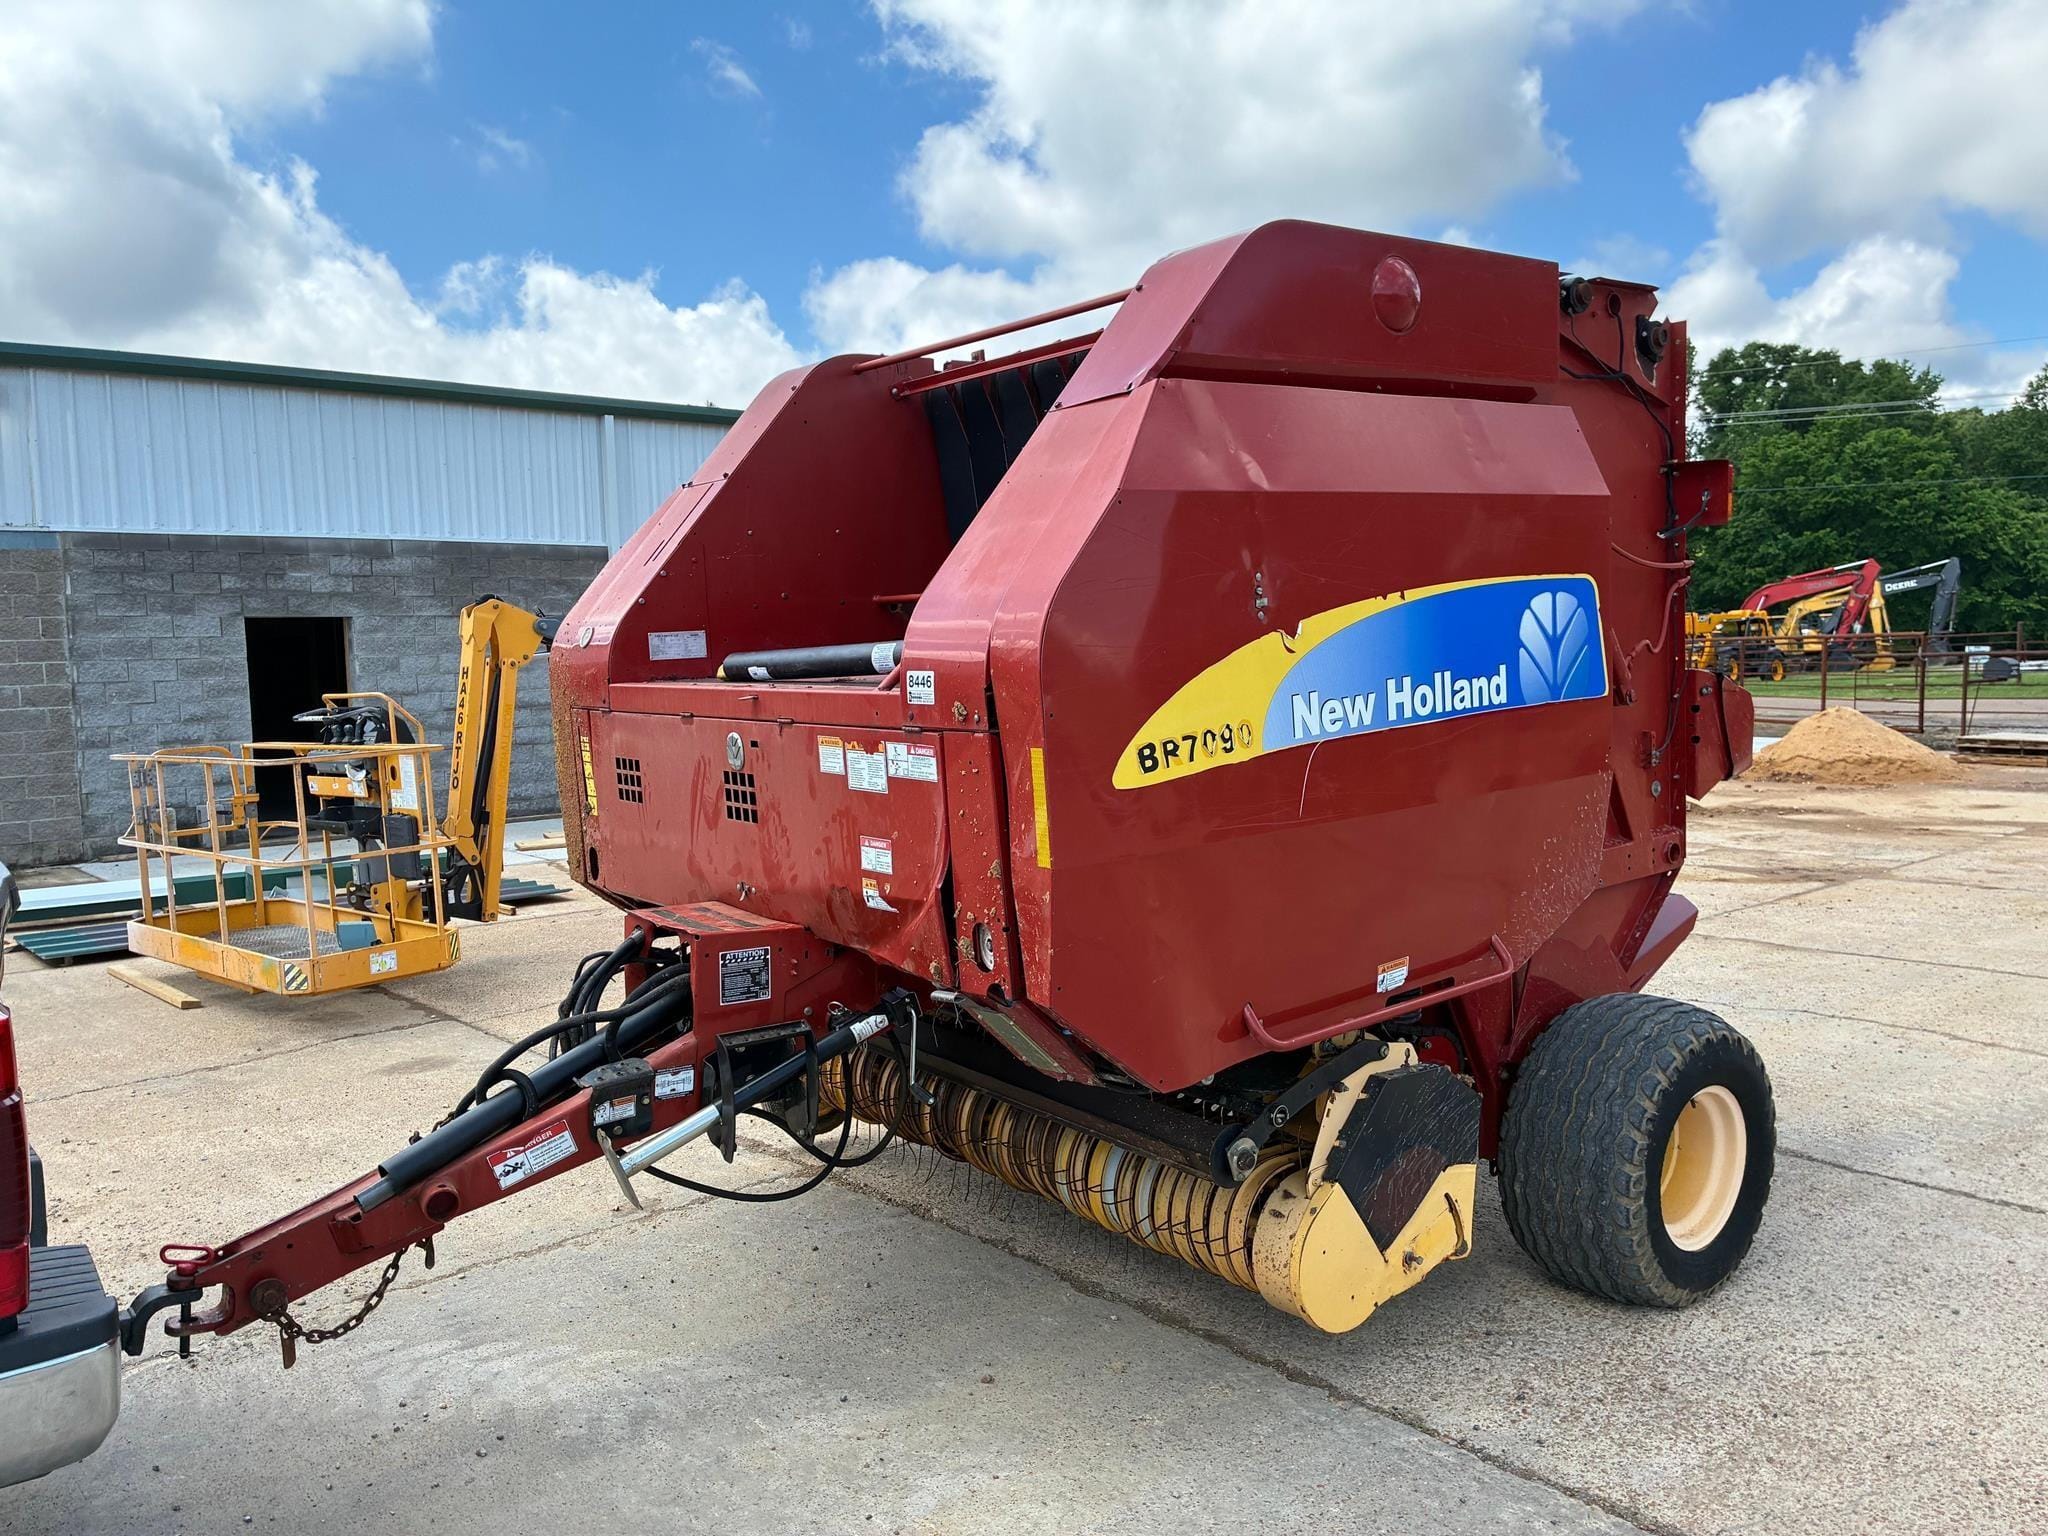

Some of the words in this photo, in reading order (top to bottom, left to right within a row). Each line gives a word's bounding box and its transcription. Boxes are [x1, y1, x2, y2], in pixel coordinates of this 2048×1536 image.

[1884, 579, 1919, 592] DEERE
[908, 674, 932, 688] 8446
[1291, 689, 1375, 740] New
[1386, 663, 1507, 722] Holland
[1137, 718, 1253, 775] BR7090
[725, 949, 765, 960] ATTENTION
